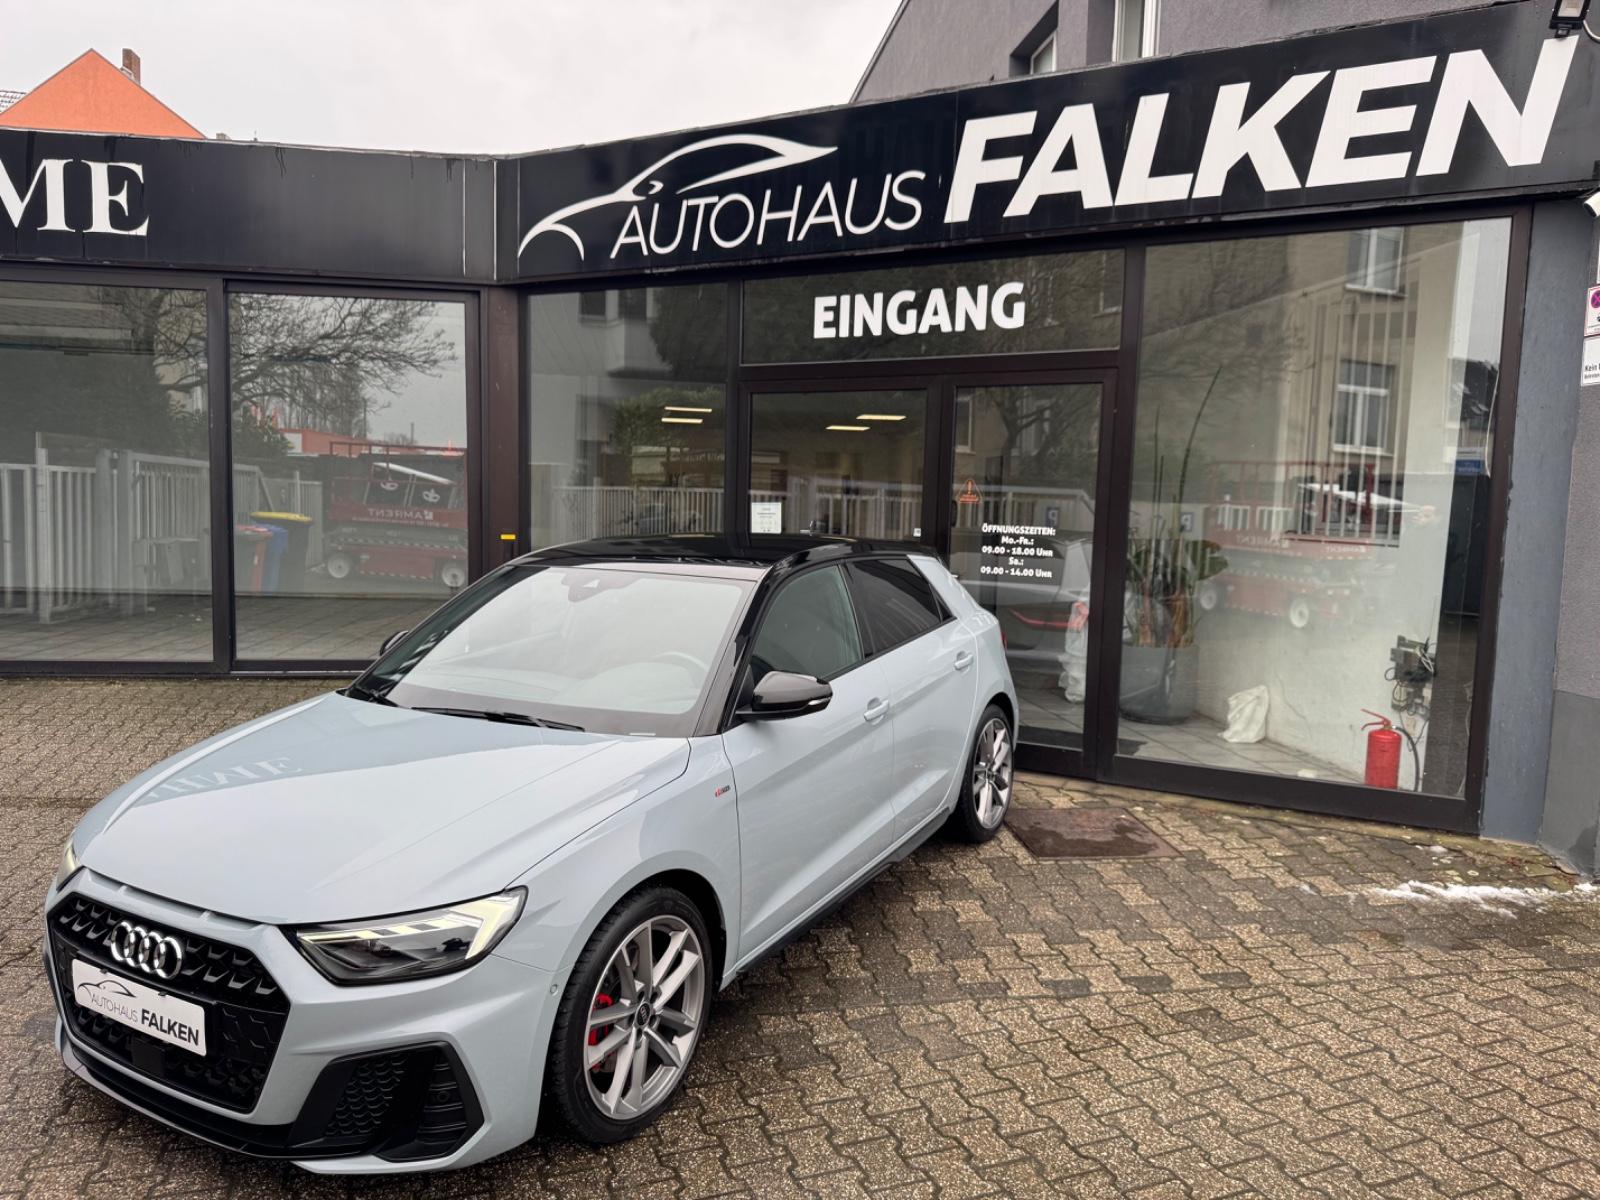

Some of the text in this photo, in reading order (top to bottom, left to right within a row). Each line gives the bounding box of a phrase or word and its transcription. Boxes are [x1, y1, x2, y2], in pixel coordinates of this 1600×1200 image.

[610, 35, 1580, 259] AUTOHAUS FALKEN
[814, 281, 1026, 338] EINGANG
[982, 523, 1056, 536] ÖFFNUNGSZEITEN:
[982, 546, 1006, 555] 09.00
[1012, 547, 1035, 556] 18.00
[981, 566, 1004, 575] 09.00
[1010, 568, 1034, 577] 14.00
[91, 994, 199, 1046] AUTOHAUS FALKEN
